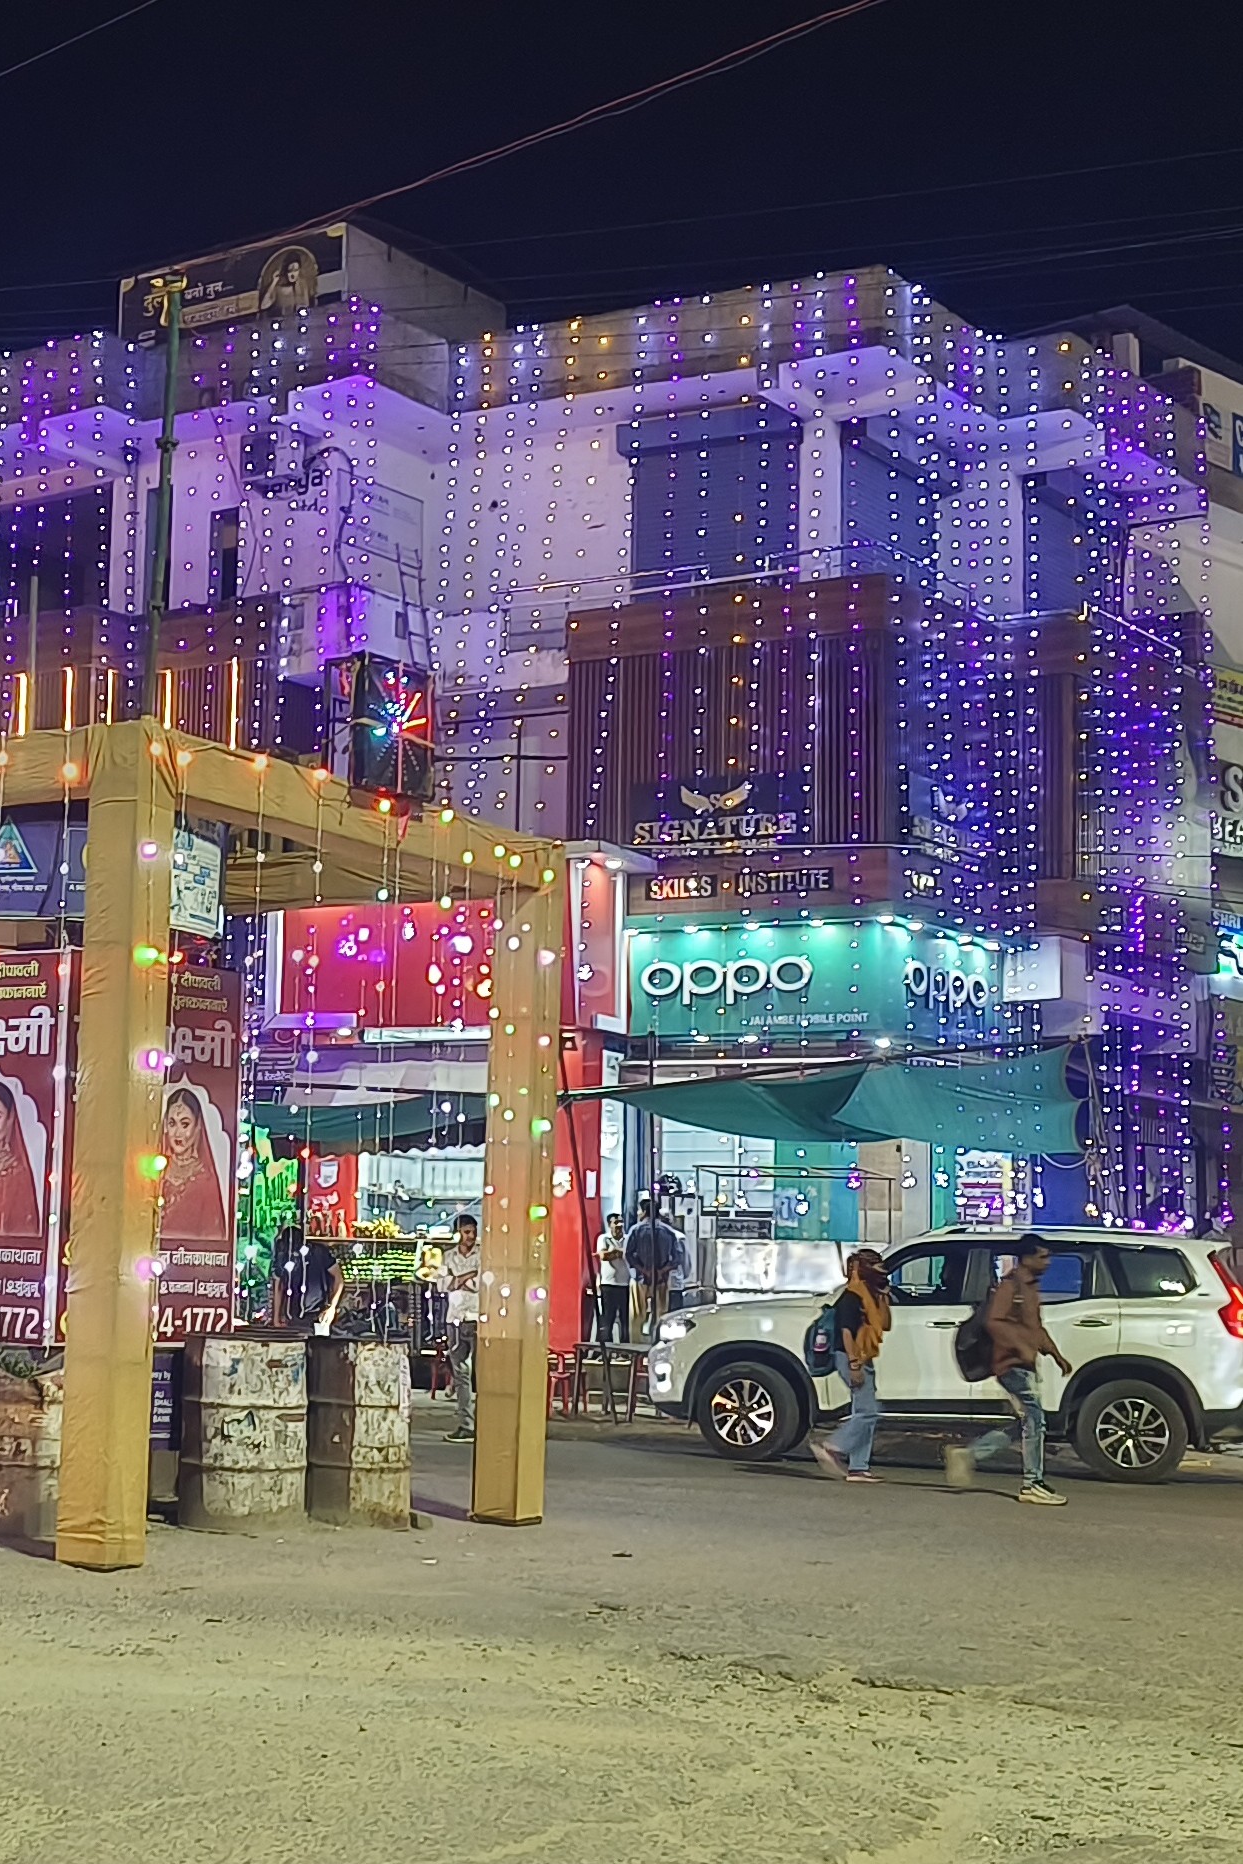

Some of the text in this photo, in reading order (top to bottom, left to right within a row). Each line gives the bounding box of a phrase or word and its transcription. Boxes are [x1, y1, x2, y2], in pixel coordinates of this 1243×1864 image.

[634, 812, 797, 844] SIGNATURE
[738, 869, 830, 894] INSTITUTE
[640, 955, 813, 1006] oppo
[906, 960, 989, 1013] oppo
[836, 1012, 869, 1024] POINT
